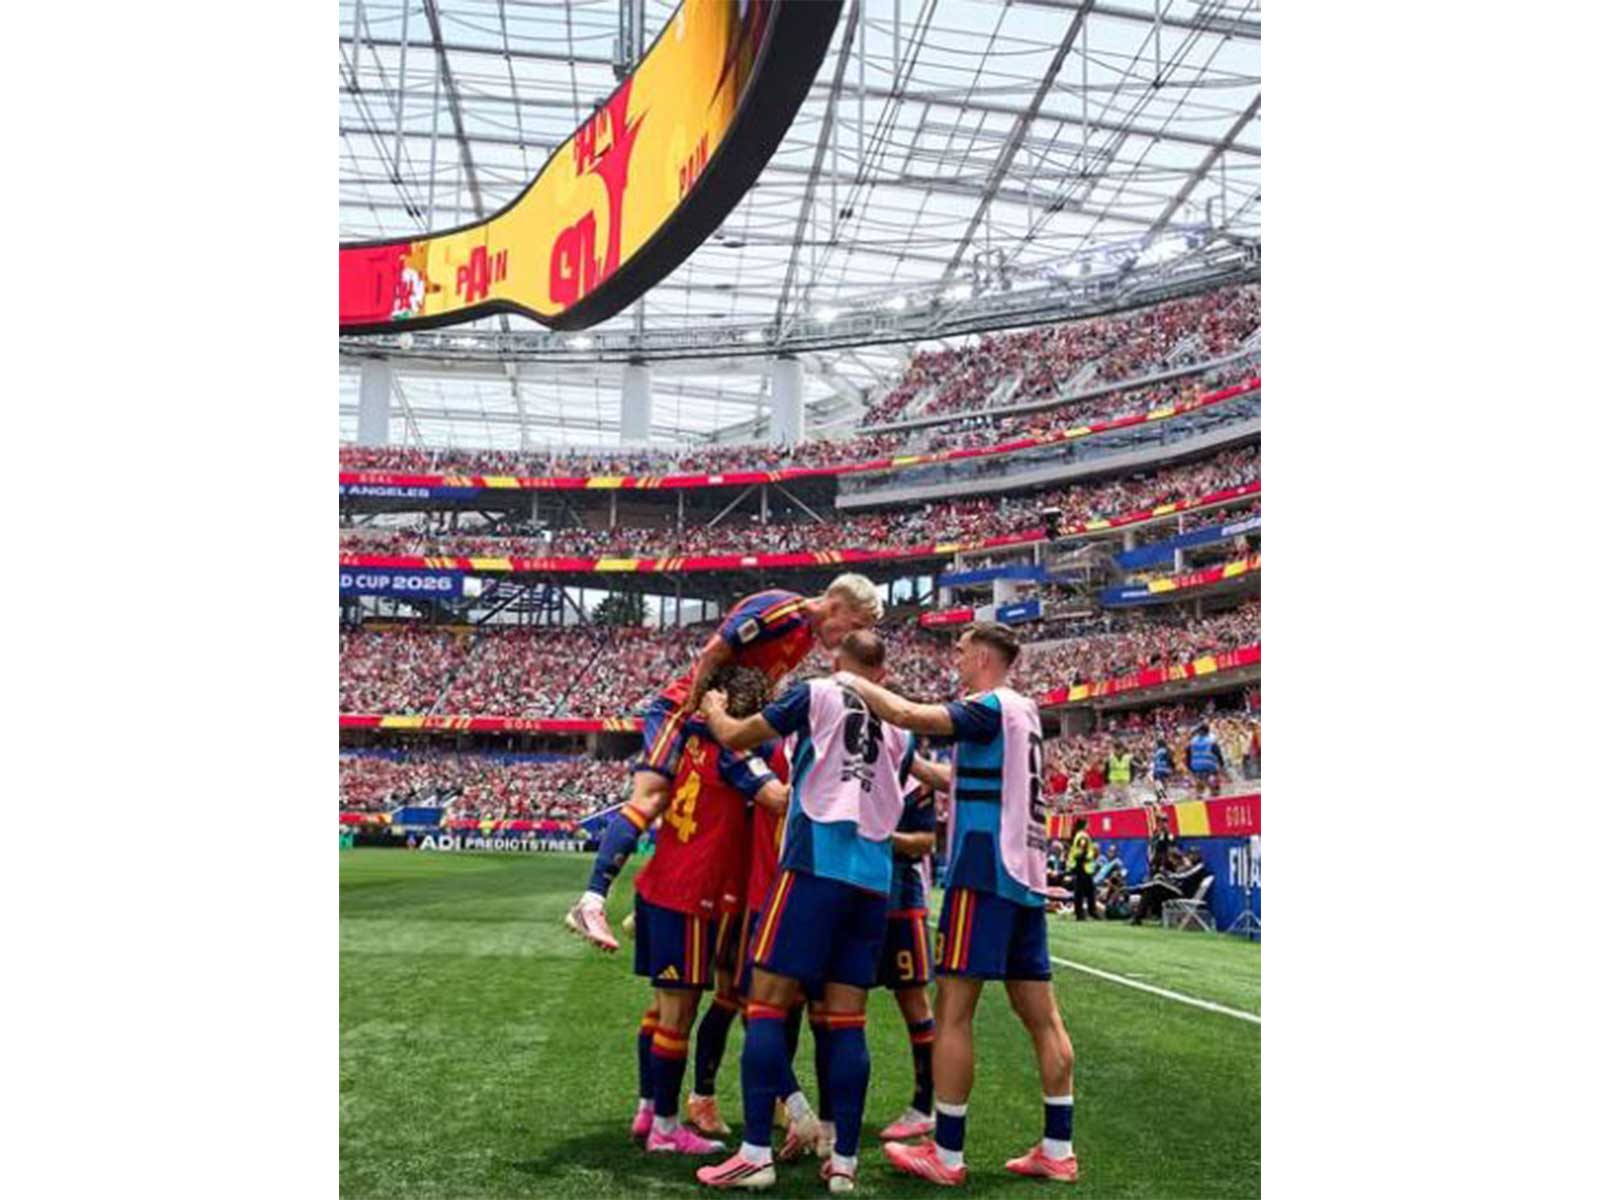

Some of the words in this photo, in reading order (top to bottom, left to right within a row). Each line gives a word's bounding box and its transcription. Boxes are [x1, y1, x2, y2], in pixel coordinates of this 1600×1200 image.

[349, 486, 429, 498] ANGELES
[356, 575, 390, 589] CUP
[392, 576, 453, 590] 2026
[665, 770, 700, 842] 4
[420, 835, 460, 849] ADI
[897, 951, 914, 980] 9
